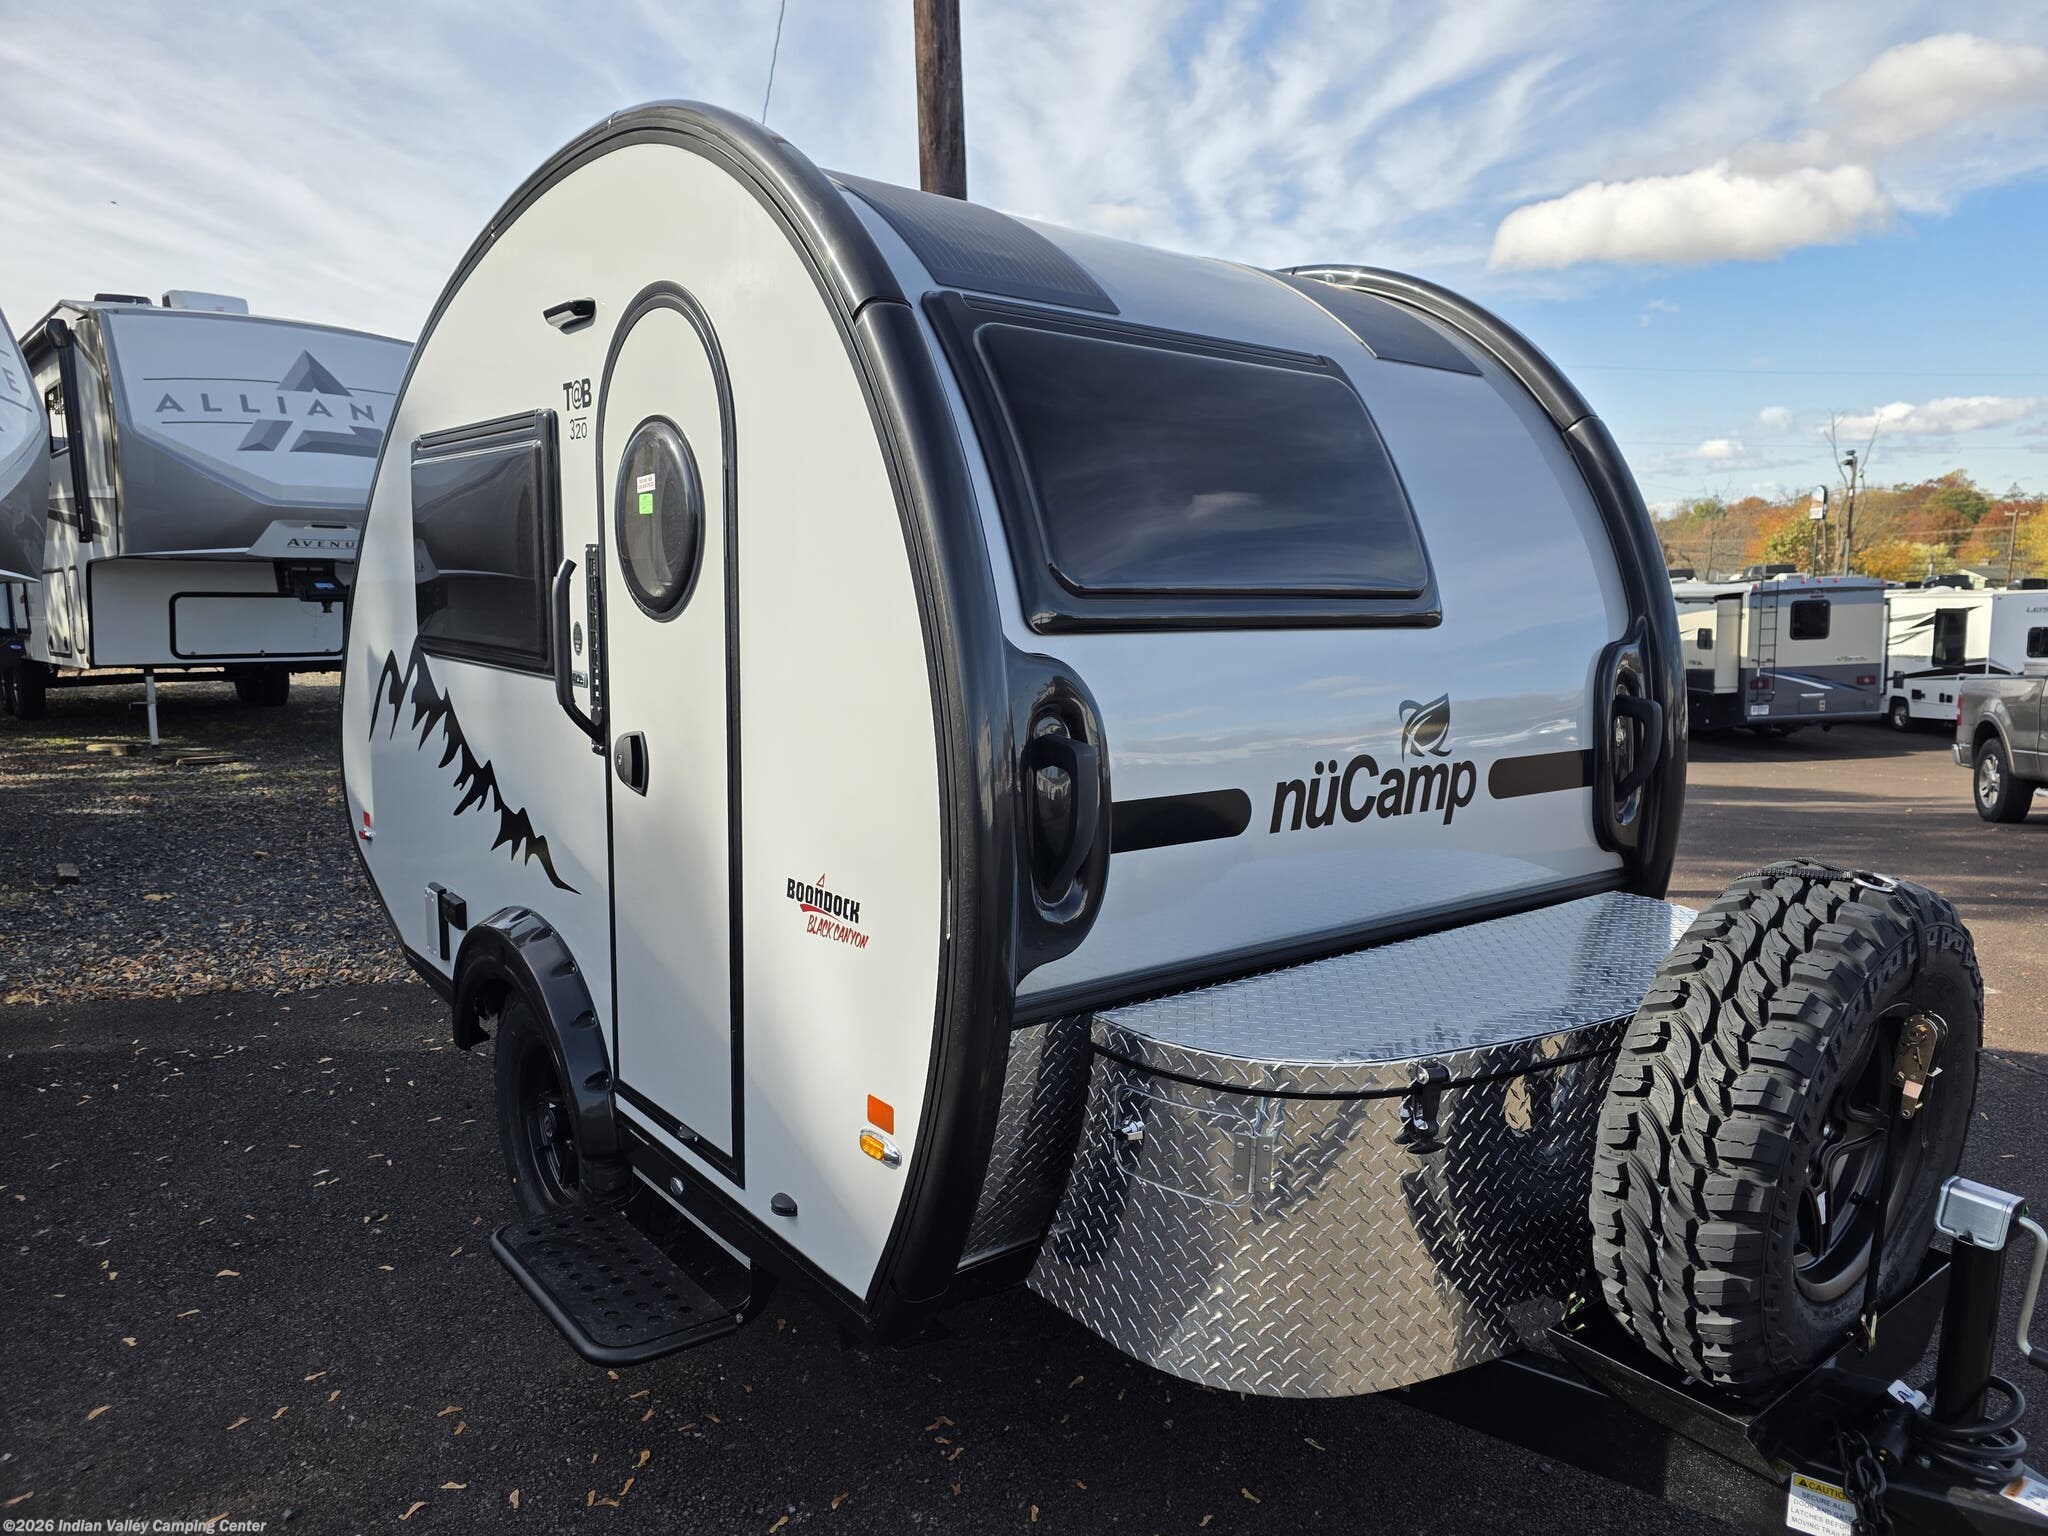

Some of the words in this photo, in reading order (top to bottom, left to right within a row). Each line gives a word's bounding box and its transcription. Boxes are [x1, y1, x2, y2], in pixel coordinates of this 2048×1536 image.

[563, 378, 592, 411] T@B
[570, 418, 588, 440] 320
[1269, 754, 1477, 834] nüCamp
[786, 877, 861, 924] BOONDOCK
[807, 914, 835, 939] BLACK
[833, 923, 869, 949] CANYON
[1793, 1499, 1815, 1511] DOOR
[1801, 1491, 1831, 1507] SECURE
[1832, 1502, 1847, 1512] ALL
[1790, 1507, 1824, 1523] LATCHES
[1791, 1516, 1820, 1531] MOVING
